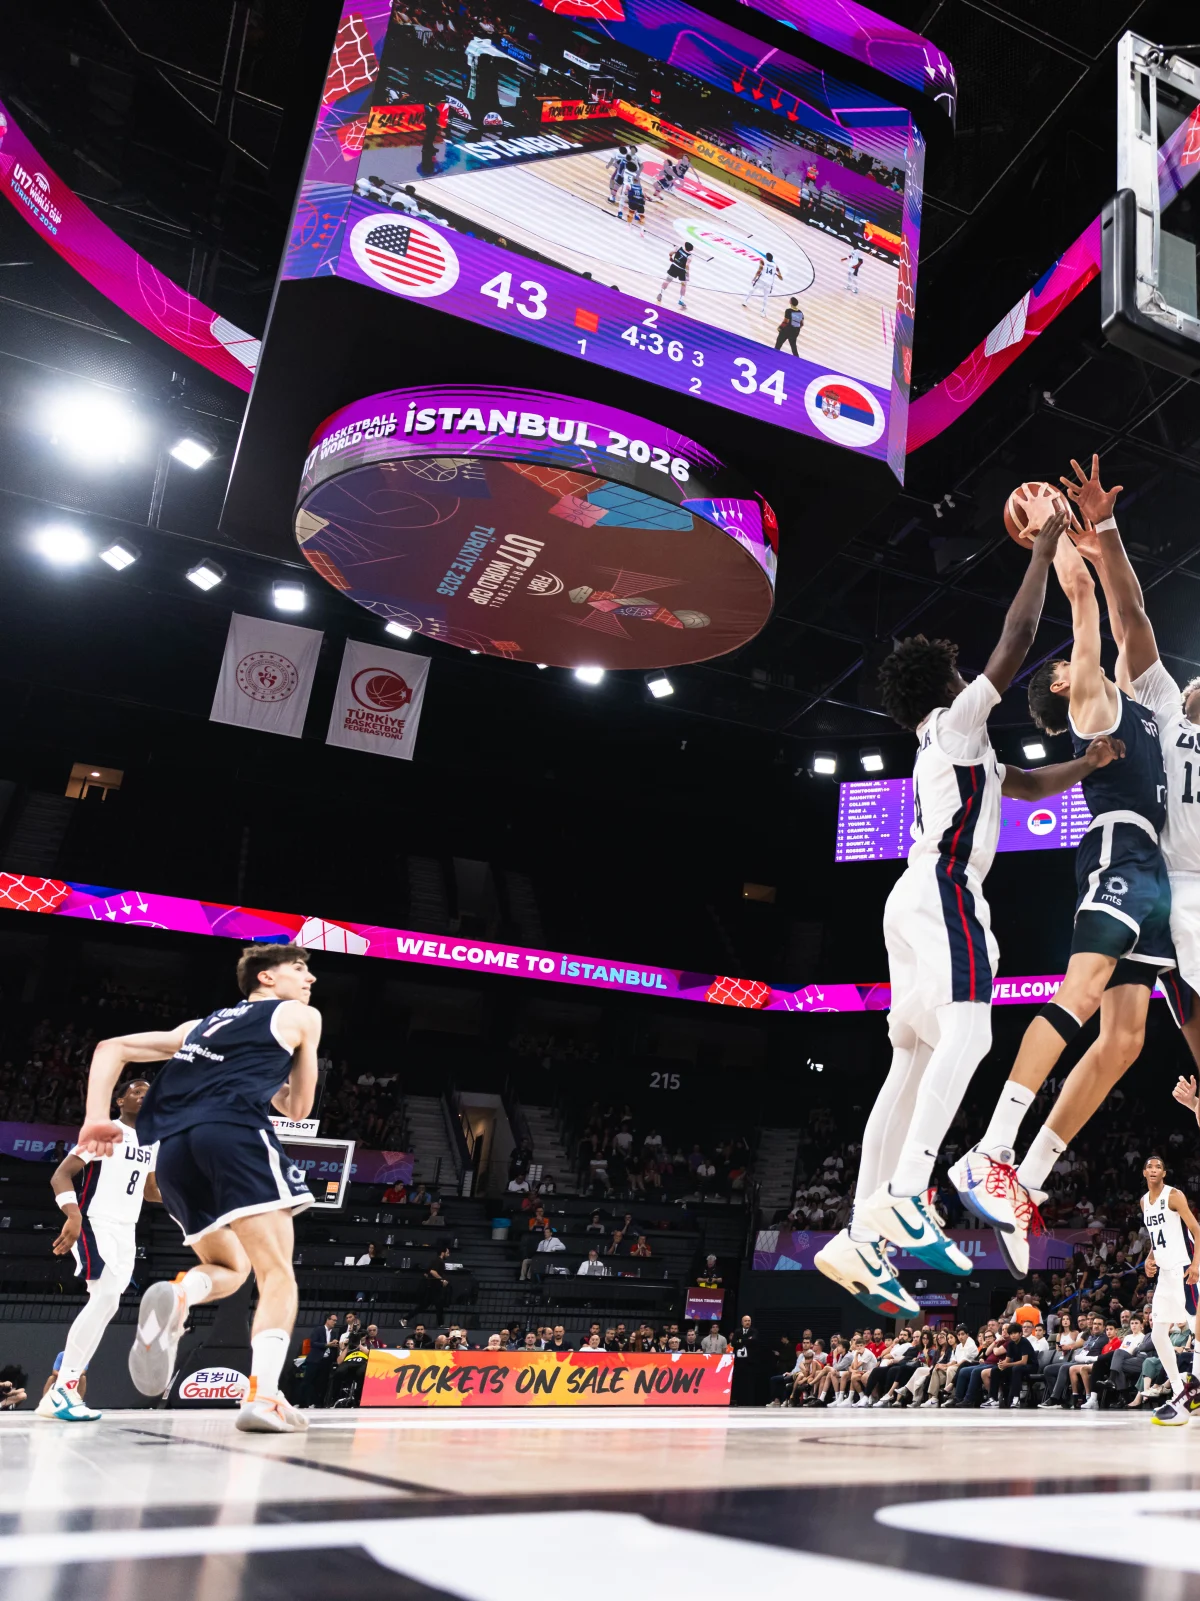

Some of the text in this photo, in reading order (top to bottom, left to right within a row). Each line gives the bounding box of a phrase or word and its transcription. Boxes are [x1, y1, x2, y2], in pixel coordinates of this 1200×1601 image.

[13, 163, 33, 190] U17
[29, 186, 62, 225] WORLD CUP
[480, 271, 548, 320] 43
[642, 308, 659, 328] 2
[577, 339, 587, 355] 1
[621, 325, 684, 362] 4:36
[691, 350, 704, 367] 3
[689, 377, 702, 394] 2
[730, 357, 788, 406] 34
[321, 413, 397, 447] BASKETBALL
[320, 424, 397, 460] WORLD CUP
[404, 402, 691, 483] İSTANBUL 2026
[496, 533, 545, 567] U17
[436, 525, 497, 597] TÜRKİYE 2026
[467, 559, 513, 605] WORLD CUP
[527, 574, 554, 592] FIBA
[345, 718, 404, 735] BASKETBOL
[346, 708, 406, 728] TÜRKİYE
[343, 724, 403, 741] FEDERASYONU
[1101, 893, 1123, 906] mts
[396, 936, 668, 990] WELCOME TO İSTANBUL
[173, 1051, 195, 1064] ank
[650, 1071, 681, 1090] 215
[281, 1121, 316, 1130] TISSOT
[125, 1145, 152, 1165] USA
[126, 1170, 140, 1195] 8
[1146, 1212, 1166, 1227] USA
[1150, 1229, 1167, 1251] 14
[196, 1372, 239, 1384] 百岁山
[394, 1364, 705, 1394] TICKETS ON SALE NOW!
